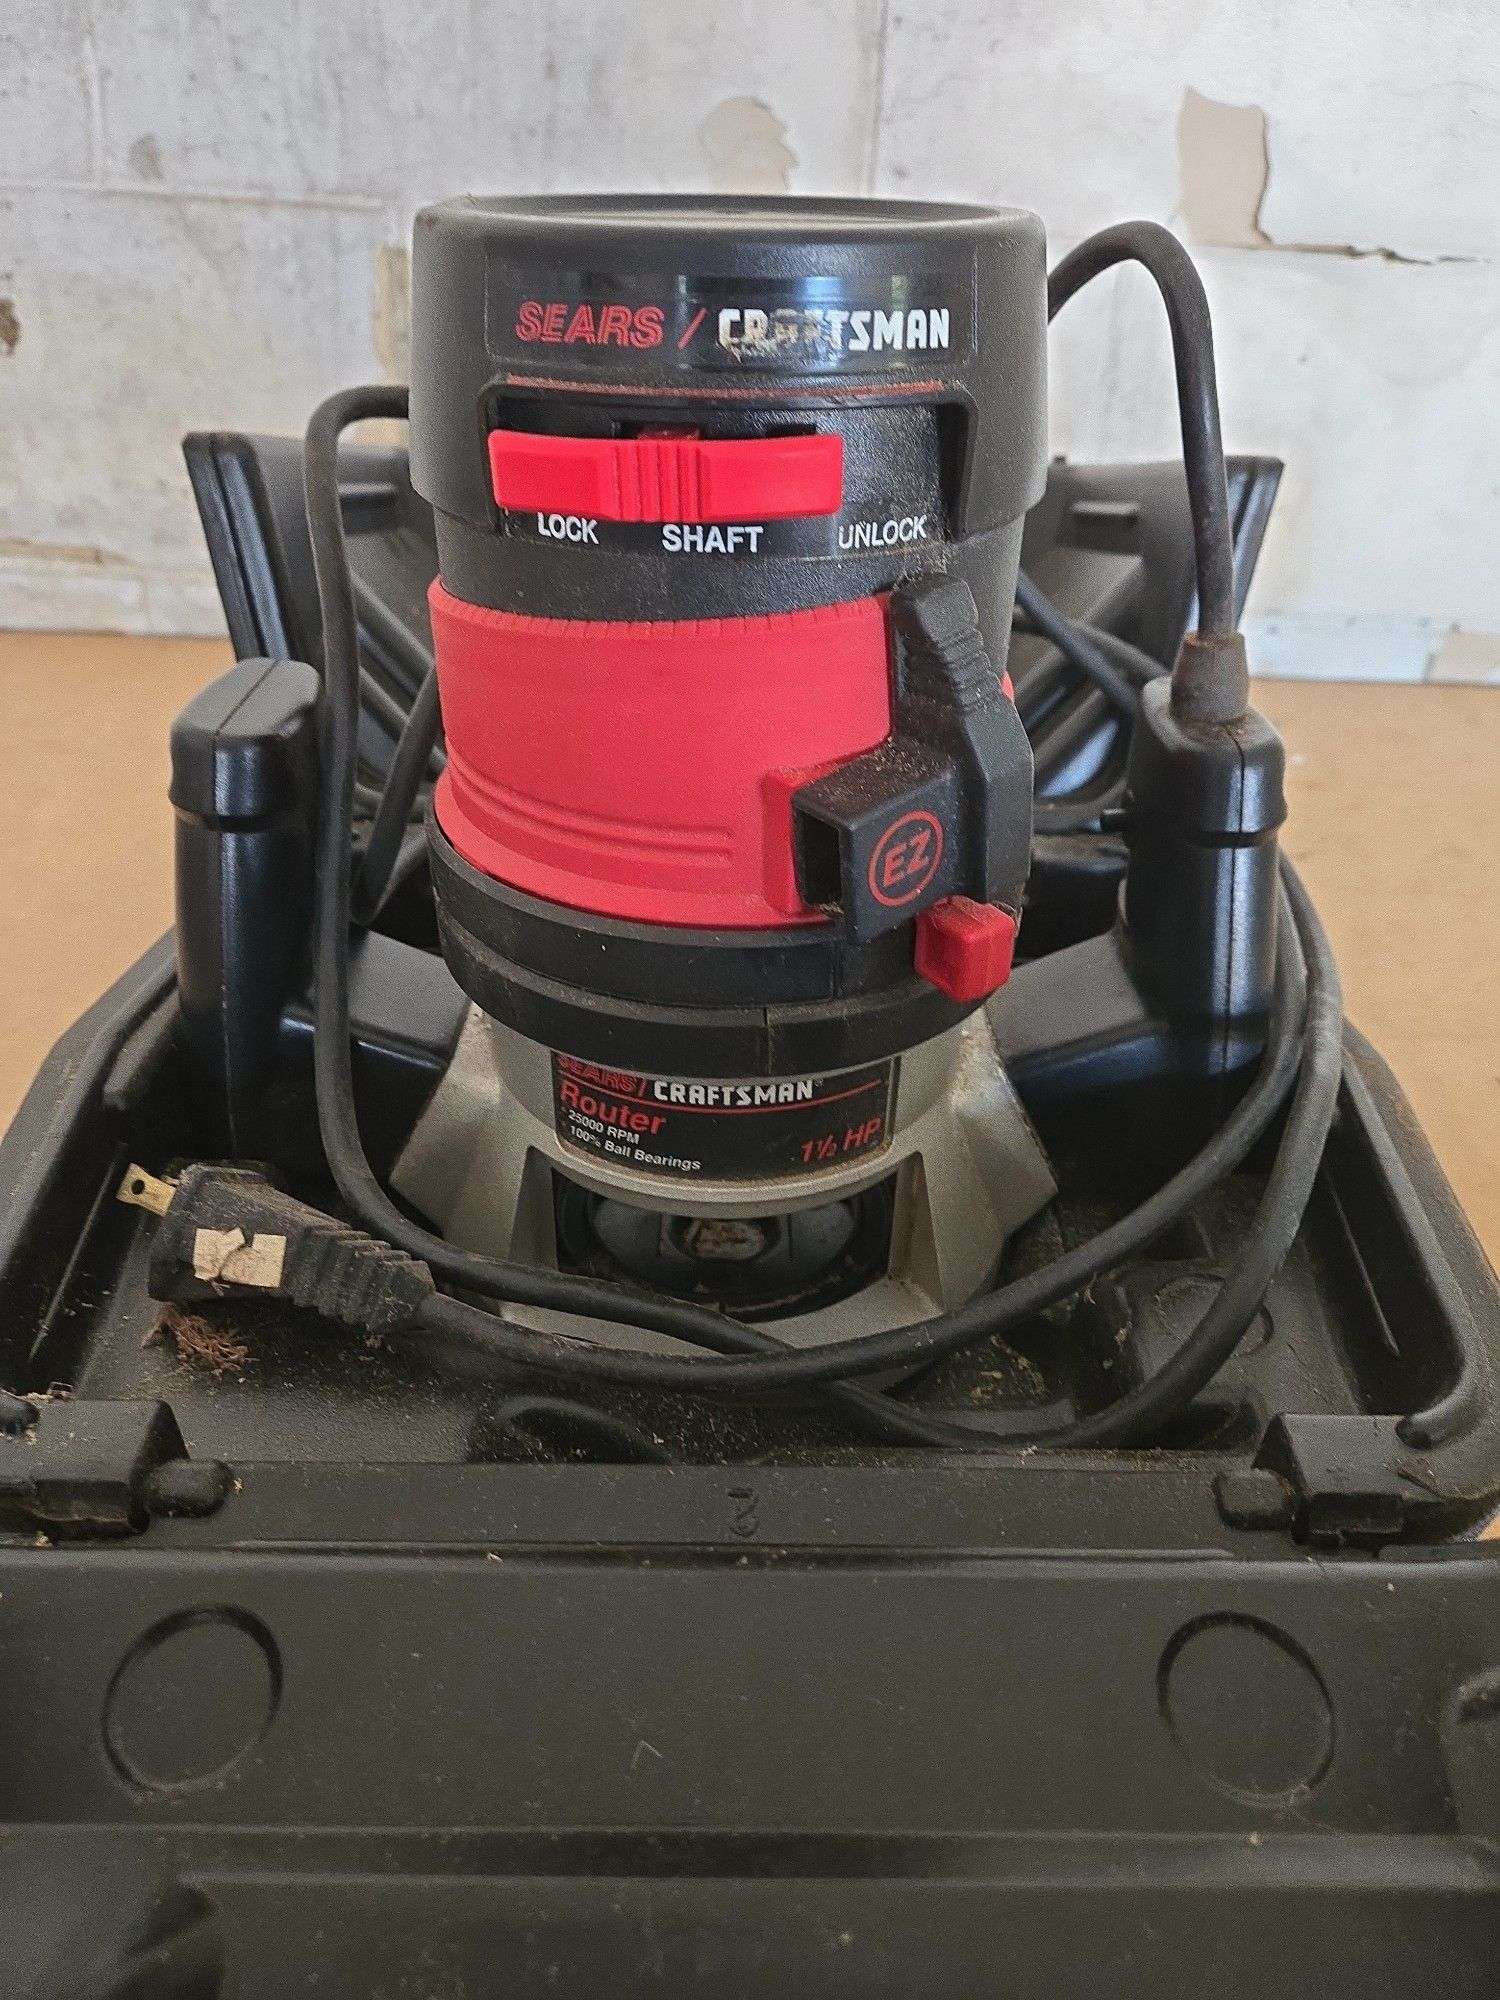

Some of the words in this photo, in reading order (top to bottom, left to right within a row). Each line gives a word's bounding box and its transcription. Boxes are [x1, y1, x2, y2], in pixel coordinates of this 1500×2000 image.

[515, 300, 665, 350] SEARS
[537, 512, 599, 545] LOCK
[662, 524, 764, 554] SHAFT
[837, 514, 927, 550] UNLOCK
[883, 828, 932, 888] EZ
[560, 1079, 667, 1136] Router
[568, 1109, 604, 1134] 25000
[606, 1125, 640, 1146] RPM
[842, 1115, 882, 1152] HP
[603, 1139, 632, 1158] Ball
[633, 1148, 703, 1173] Bearings
